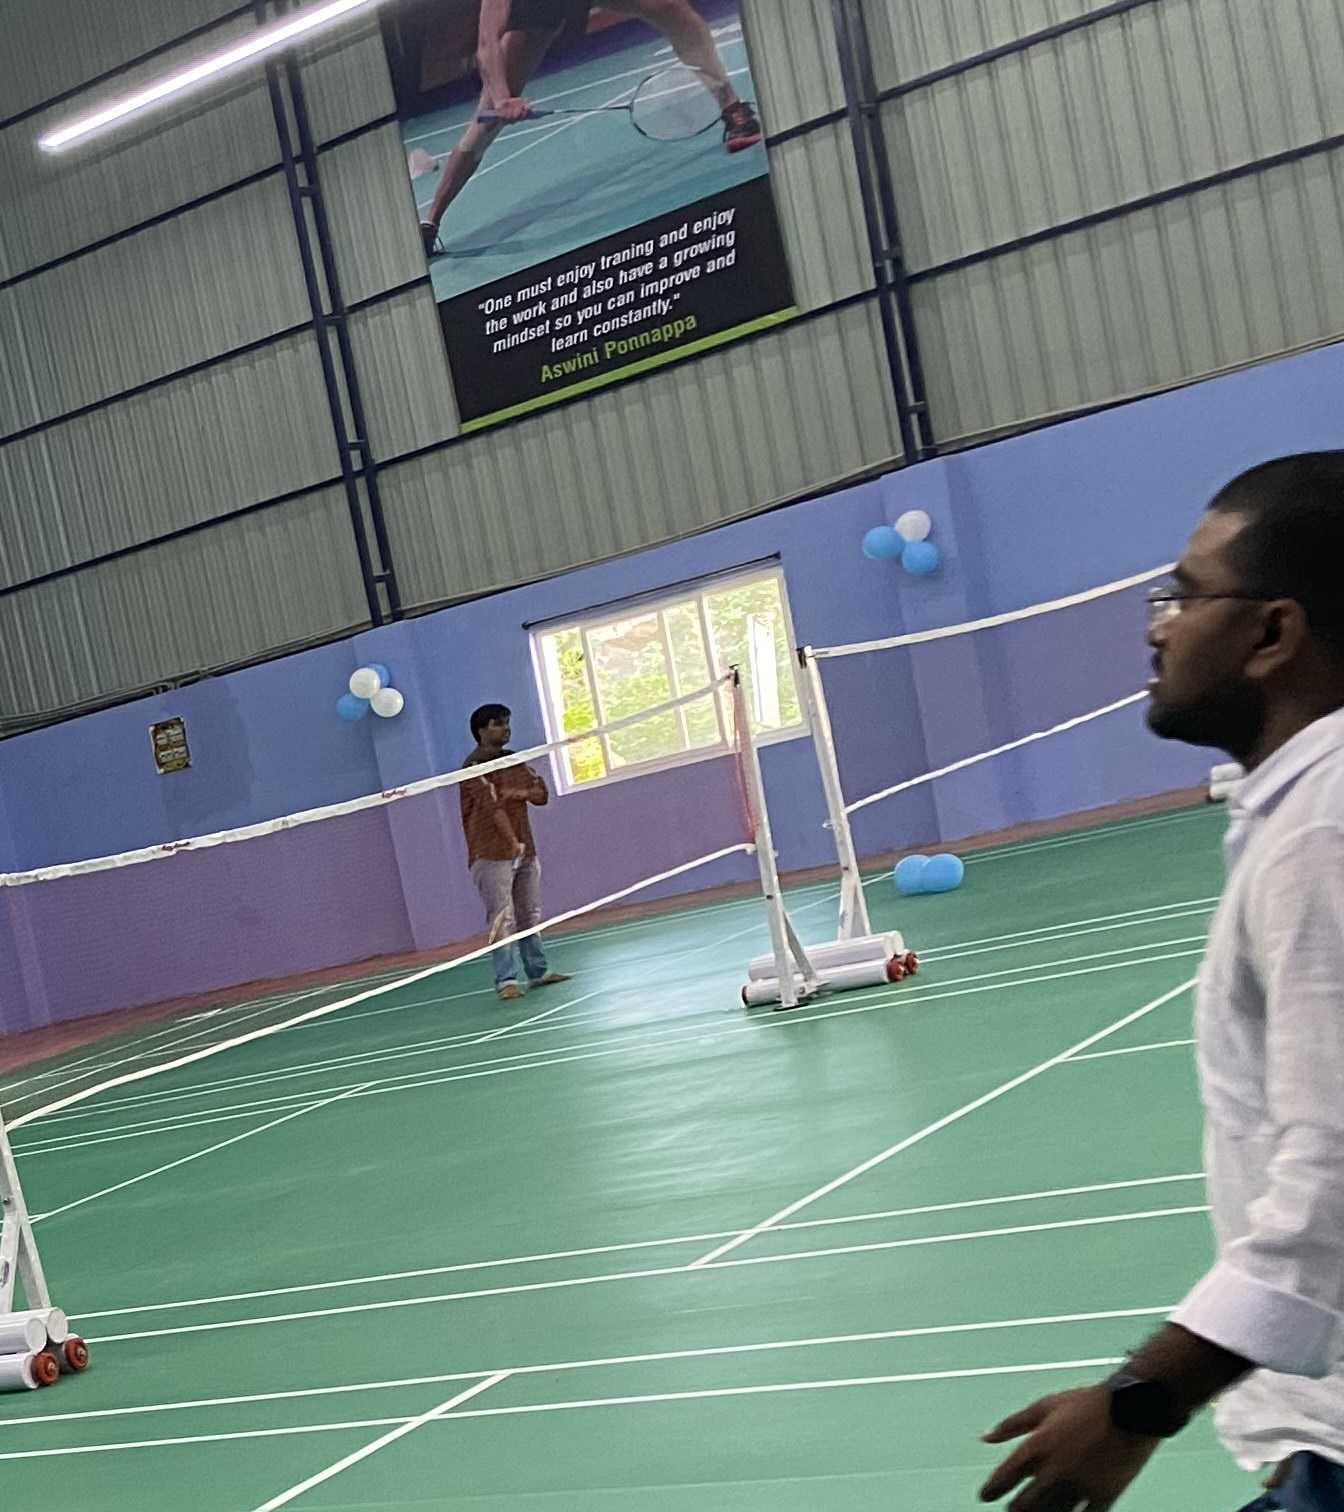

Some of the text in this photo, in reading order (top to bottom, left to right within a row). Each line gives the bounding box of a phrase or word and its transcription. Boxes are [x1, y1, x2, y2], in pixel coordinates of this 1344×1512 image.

[485, 230, 736, 335] the work and also have a growing
[493, 249, 737, 353] mindset so you can improve and
[517, 277, 552, 303] must
[556, 261, 596, 289] enjoy
[600, 239, 655, 271] traning
[659, 223, 688, 248] and
[692, 207, 736, 234] enjoy
[540, 313, 697, 384] Aswini Ponnappa
[551, 326, 588, 352] learn
